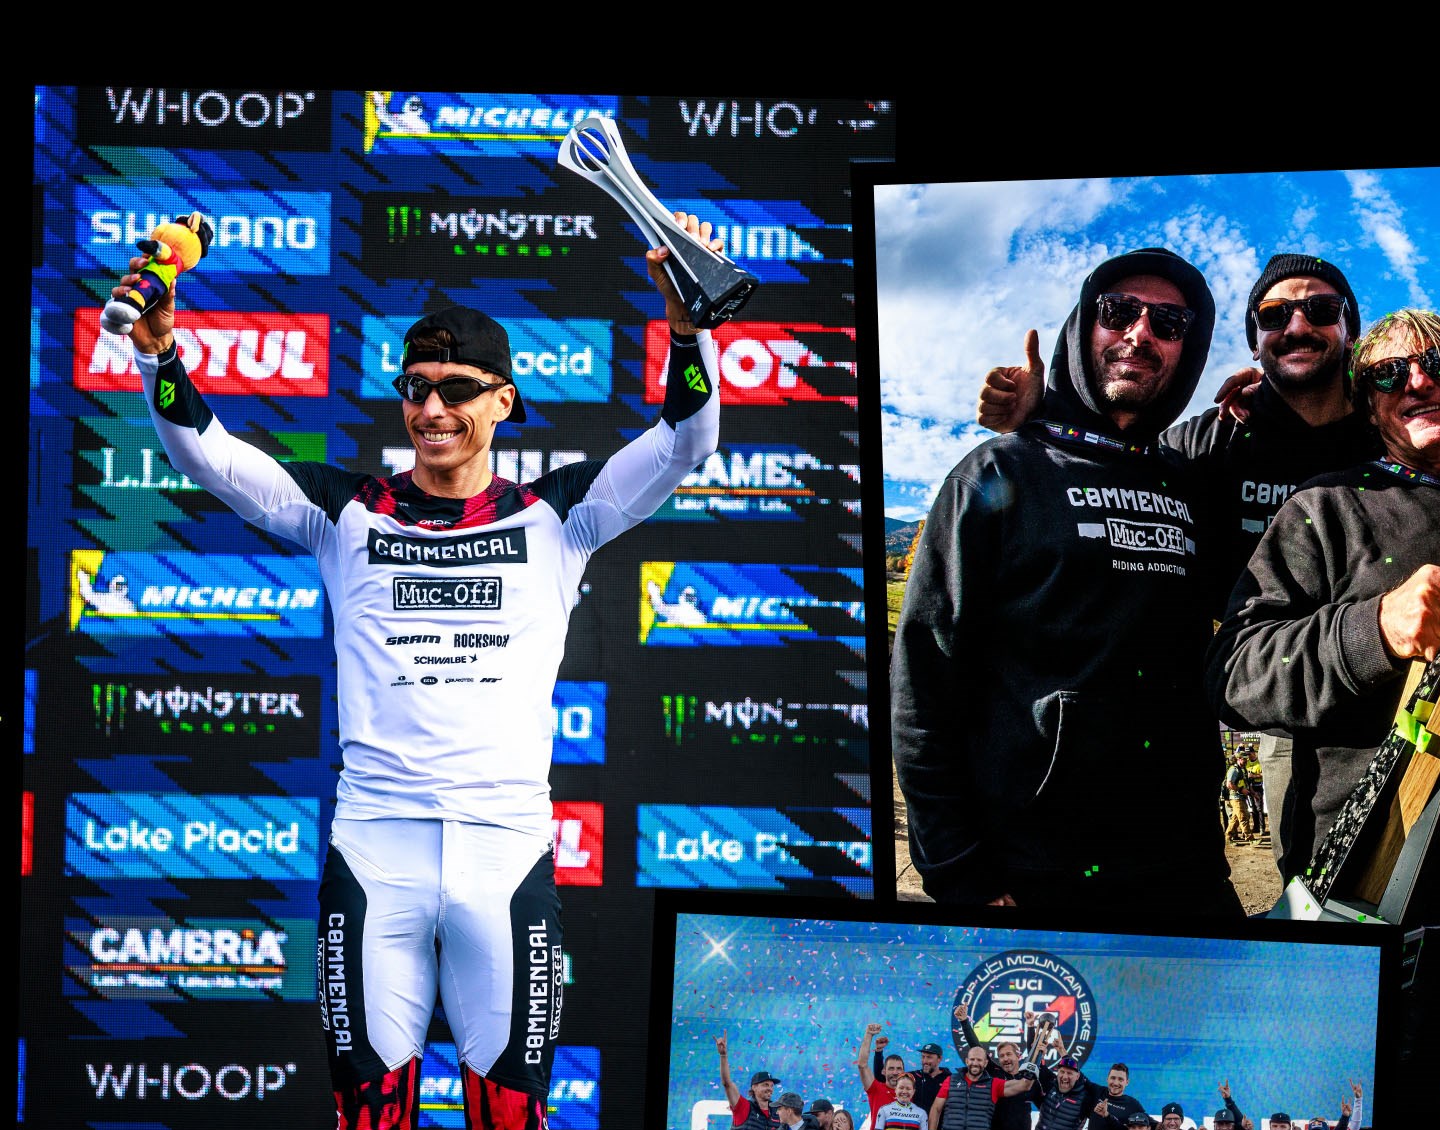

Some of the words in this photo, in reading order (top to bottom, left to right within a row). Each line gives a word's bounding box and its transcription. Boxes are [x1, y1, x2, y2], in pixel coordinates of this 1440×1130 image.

[105, 87, 305, 128] WHOOP
[90, 211, 316, 249] SHANO
[1067, 487, 1194, 525] COMMENCAL
[1112, 521, 1183, 551] Muc-Off
[1112, 559, 1145, 572] RIDING
[1147, 562, 1186, 577] ADDICTION
[140, 585, 320, 609] MICHELIN
[399, 582, 496, 605] Muc-Off
[385, 634, 441, 646] SRAM
[454, 633, 510, 648] ROCKSHOX
[414, 655, 467, 665] SCHWALBE
[86, 820, 172, 852] Lake
[185, 821, 298, 854] Placid
[658, 830, 744, 863] Lake
[1006, 954, 1086, 999] MOUNTAIN
[1079, 1001, 1092, 1042] BIKE
[1014, 978, 1043, 991] UCI
[86, 1063, 287, 1100] WHOOP
